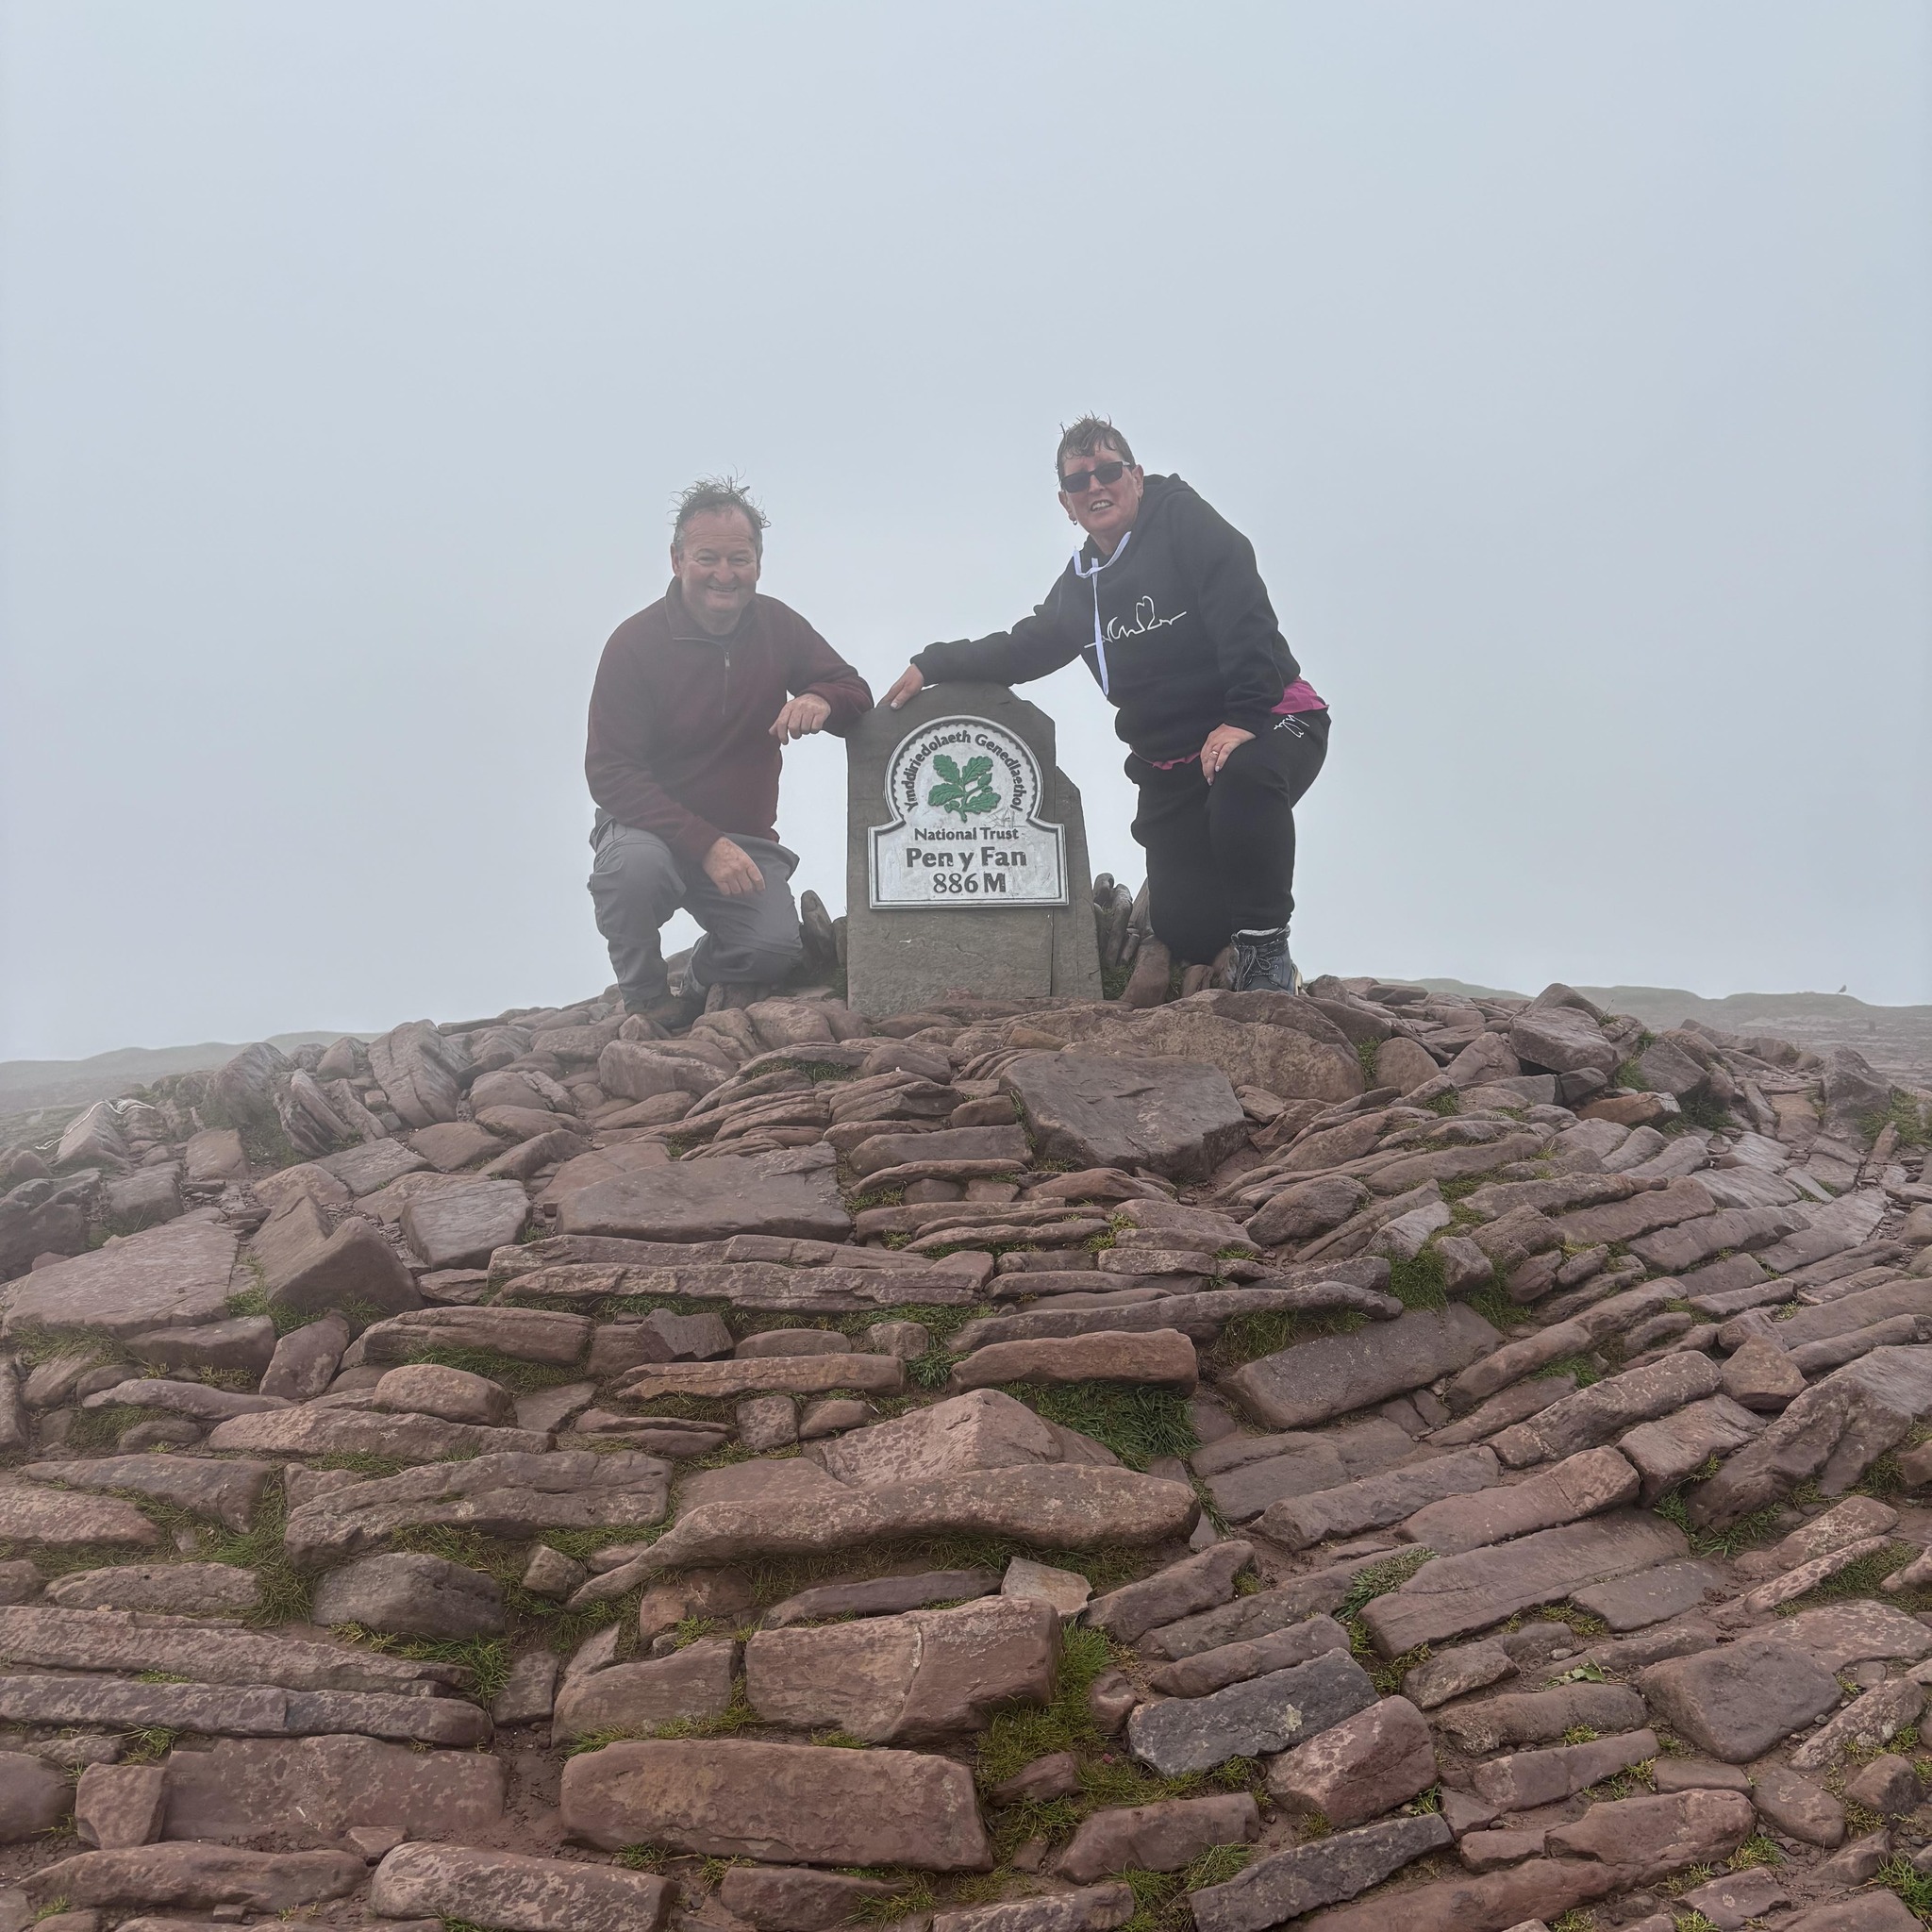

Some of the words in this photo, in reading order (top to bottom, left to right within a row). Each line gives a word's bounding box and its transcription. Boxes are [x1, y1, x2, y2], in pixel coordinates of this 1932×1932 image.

[901, 730, 972, 812] Ymddiriedolaeth
[974, 734, 1027, 811] Genedlaethol
[914, 827, 977, 841] National
[979, 827, 1019, 841] Trust
[906, 847, 954, 868] Pen
[958, 851, 974, 872] y
[980, 846, 1027, 867] Fan
[933, 873, 978, 893] 886
[984, 873, 1007, 892] M
